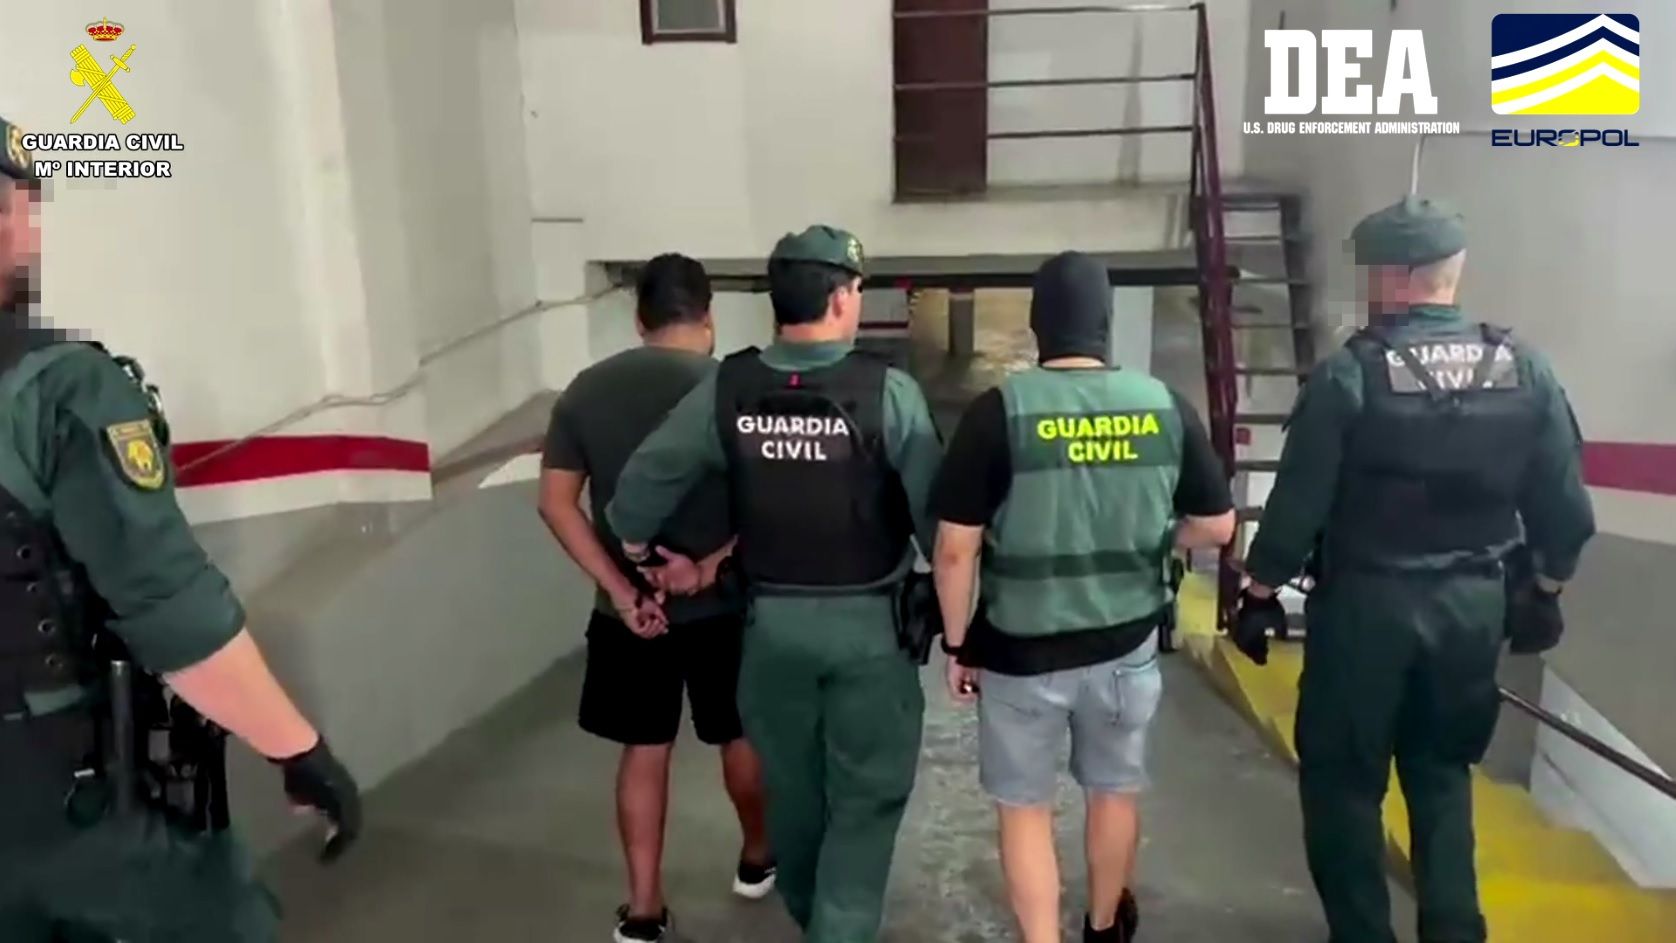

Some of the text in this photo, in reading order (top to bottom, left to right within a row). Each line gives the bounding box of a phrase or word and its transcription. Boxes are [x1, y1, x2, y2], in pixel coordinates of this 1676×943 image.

[1386, 343, 1513, 367] GUARDA
[737, 415, 849, 436] GUARDIA
[1037, 413, 1159, 440] GUARDIA
[761, 440, 827, 460] CIVIL
[1068, 440, 1138, 463] CIVIL
